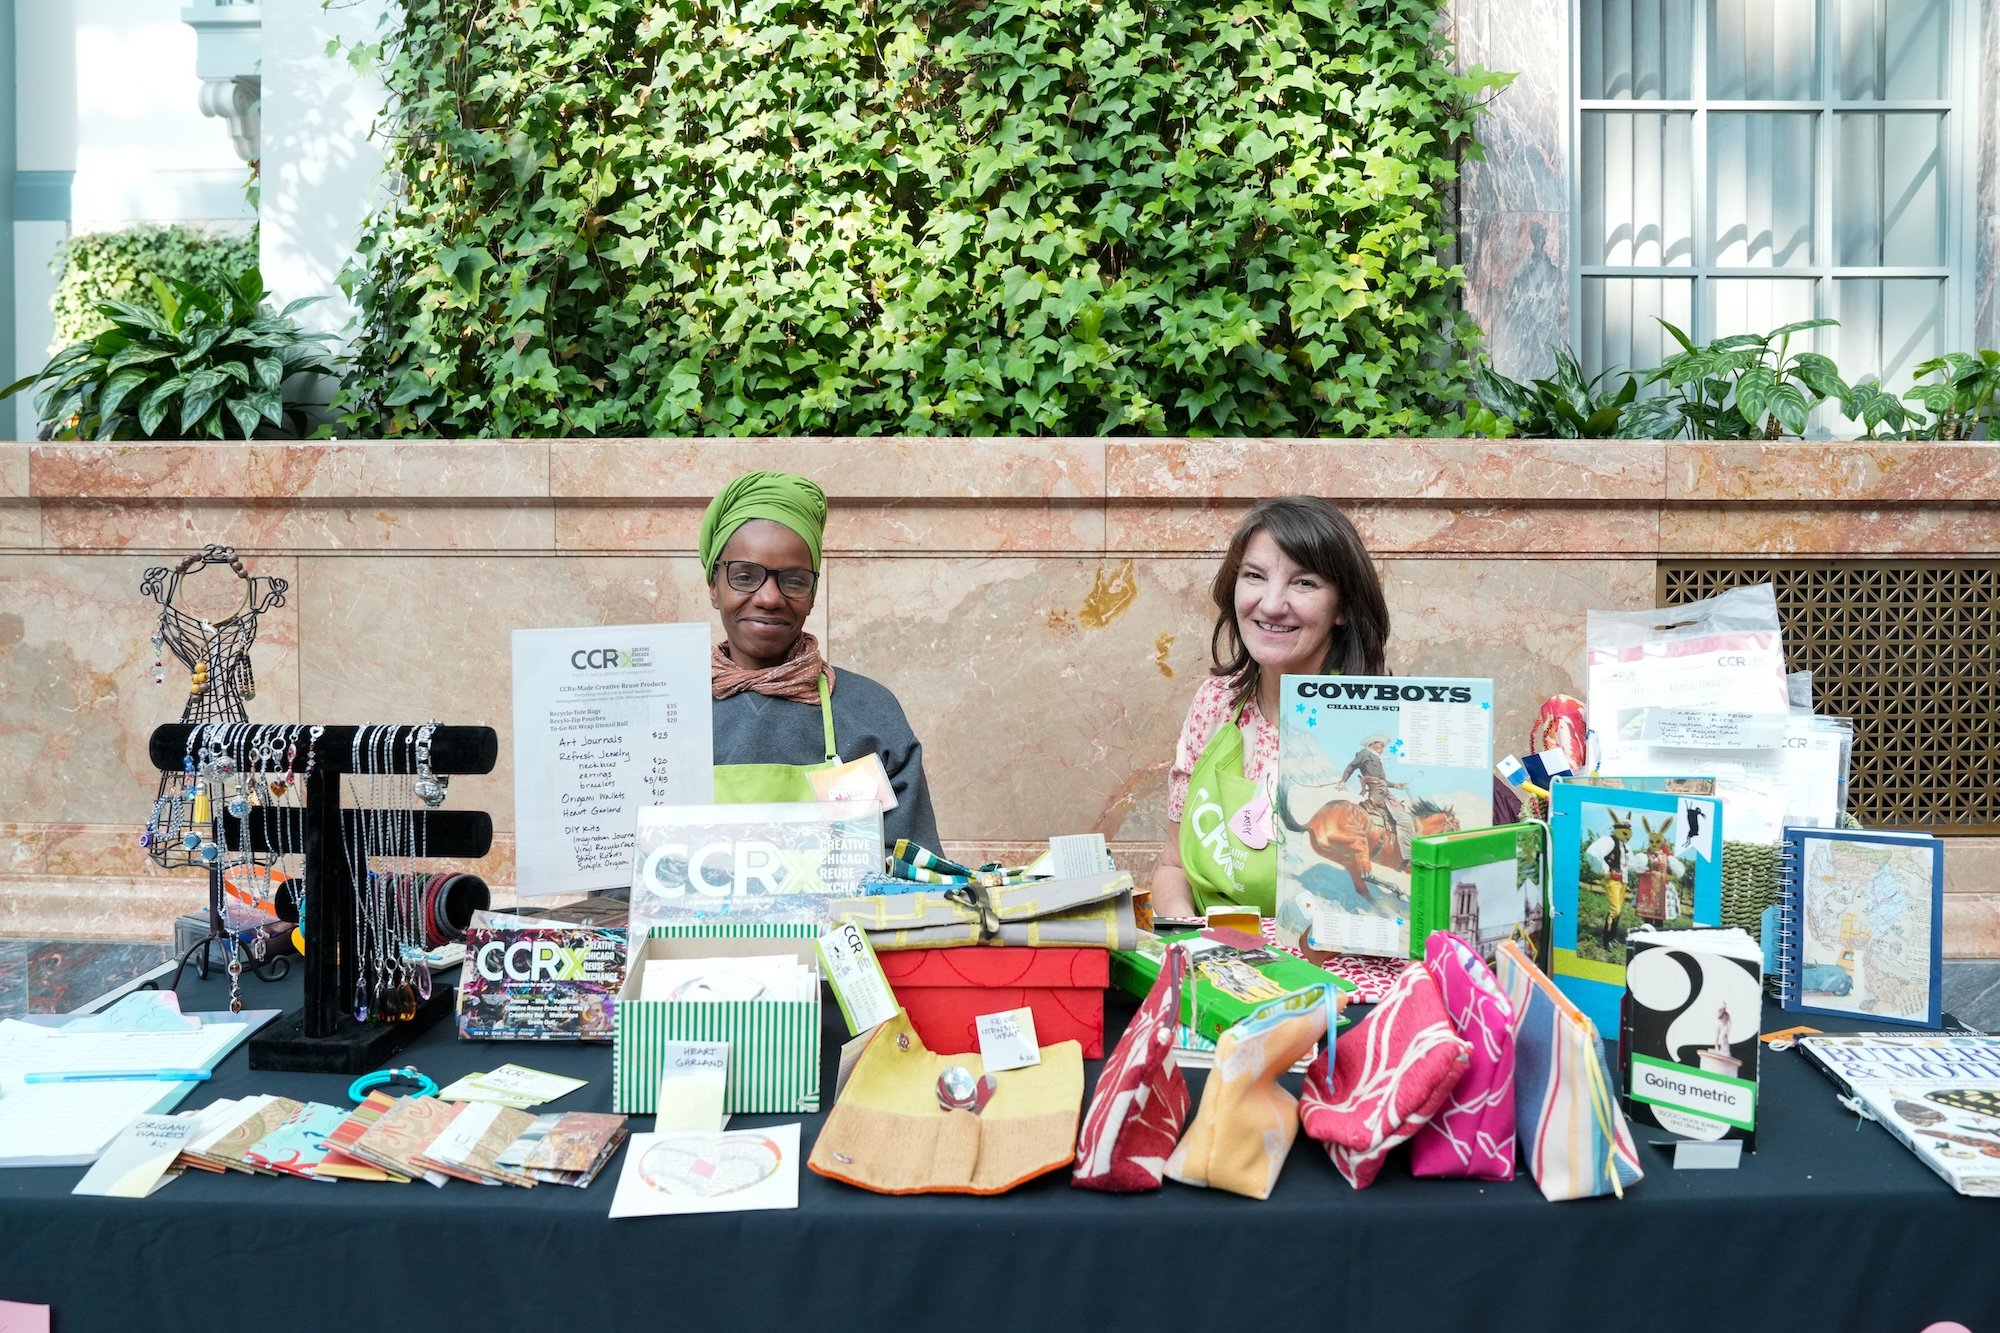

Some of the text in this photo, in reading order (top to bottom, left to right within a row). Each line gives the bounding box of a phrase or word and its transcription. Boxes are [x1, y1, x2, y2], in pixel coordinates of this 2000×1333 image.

[1297, 683, 1472, 703] COWBOYS
[1326, 703, 1380, 712] CHARLES
[559, 732, 668, 746] Art Journals $25
[560, 750, 595, 760] Refresh
[653, 757, 668, 765] $20
[579, 766, 666, 780] earrings $15
[580, 780, 616, 789] bracelets
[561, 789, 664, 807] Origami Wallets $10
[563, 806, 622, 818] Heart Garland
[1242, 810, 1252, 836] KATHY
[564, 826, 580, 834] DIY
[612, 832, 636, 840] Journa
[820, 840, 870, 851] CREATIVE
[574, 846, 592, 856] Vinyl
[820, 852, 869, 865] CHICAGO
[578, 859, 630, 871] Simple Origami
[820, 866, 854, 878] REUSE
[584, 940, 616, 950] CREATIVE
[584, 952, 615, 960] CHICAGO
[584, 962, 604, 971] REUSE
[584, 972, 618, 982] EXCHANGE
[549, 1012, 579, 1020] Workshops
[982, 1024, 1020, 1034] UTENSIL
[994, 1030, 1020, 1040] WRAP
[684, 1046, 718, 1056] HEART
[675, 1058, 724, 1068] GARLAND
[1645, 1072, 1736, 1105] Going metric
[136, 1122, 191, 1131] ORIGAMI
[136, 1130, 186, 1138] WALLETS
